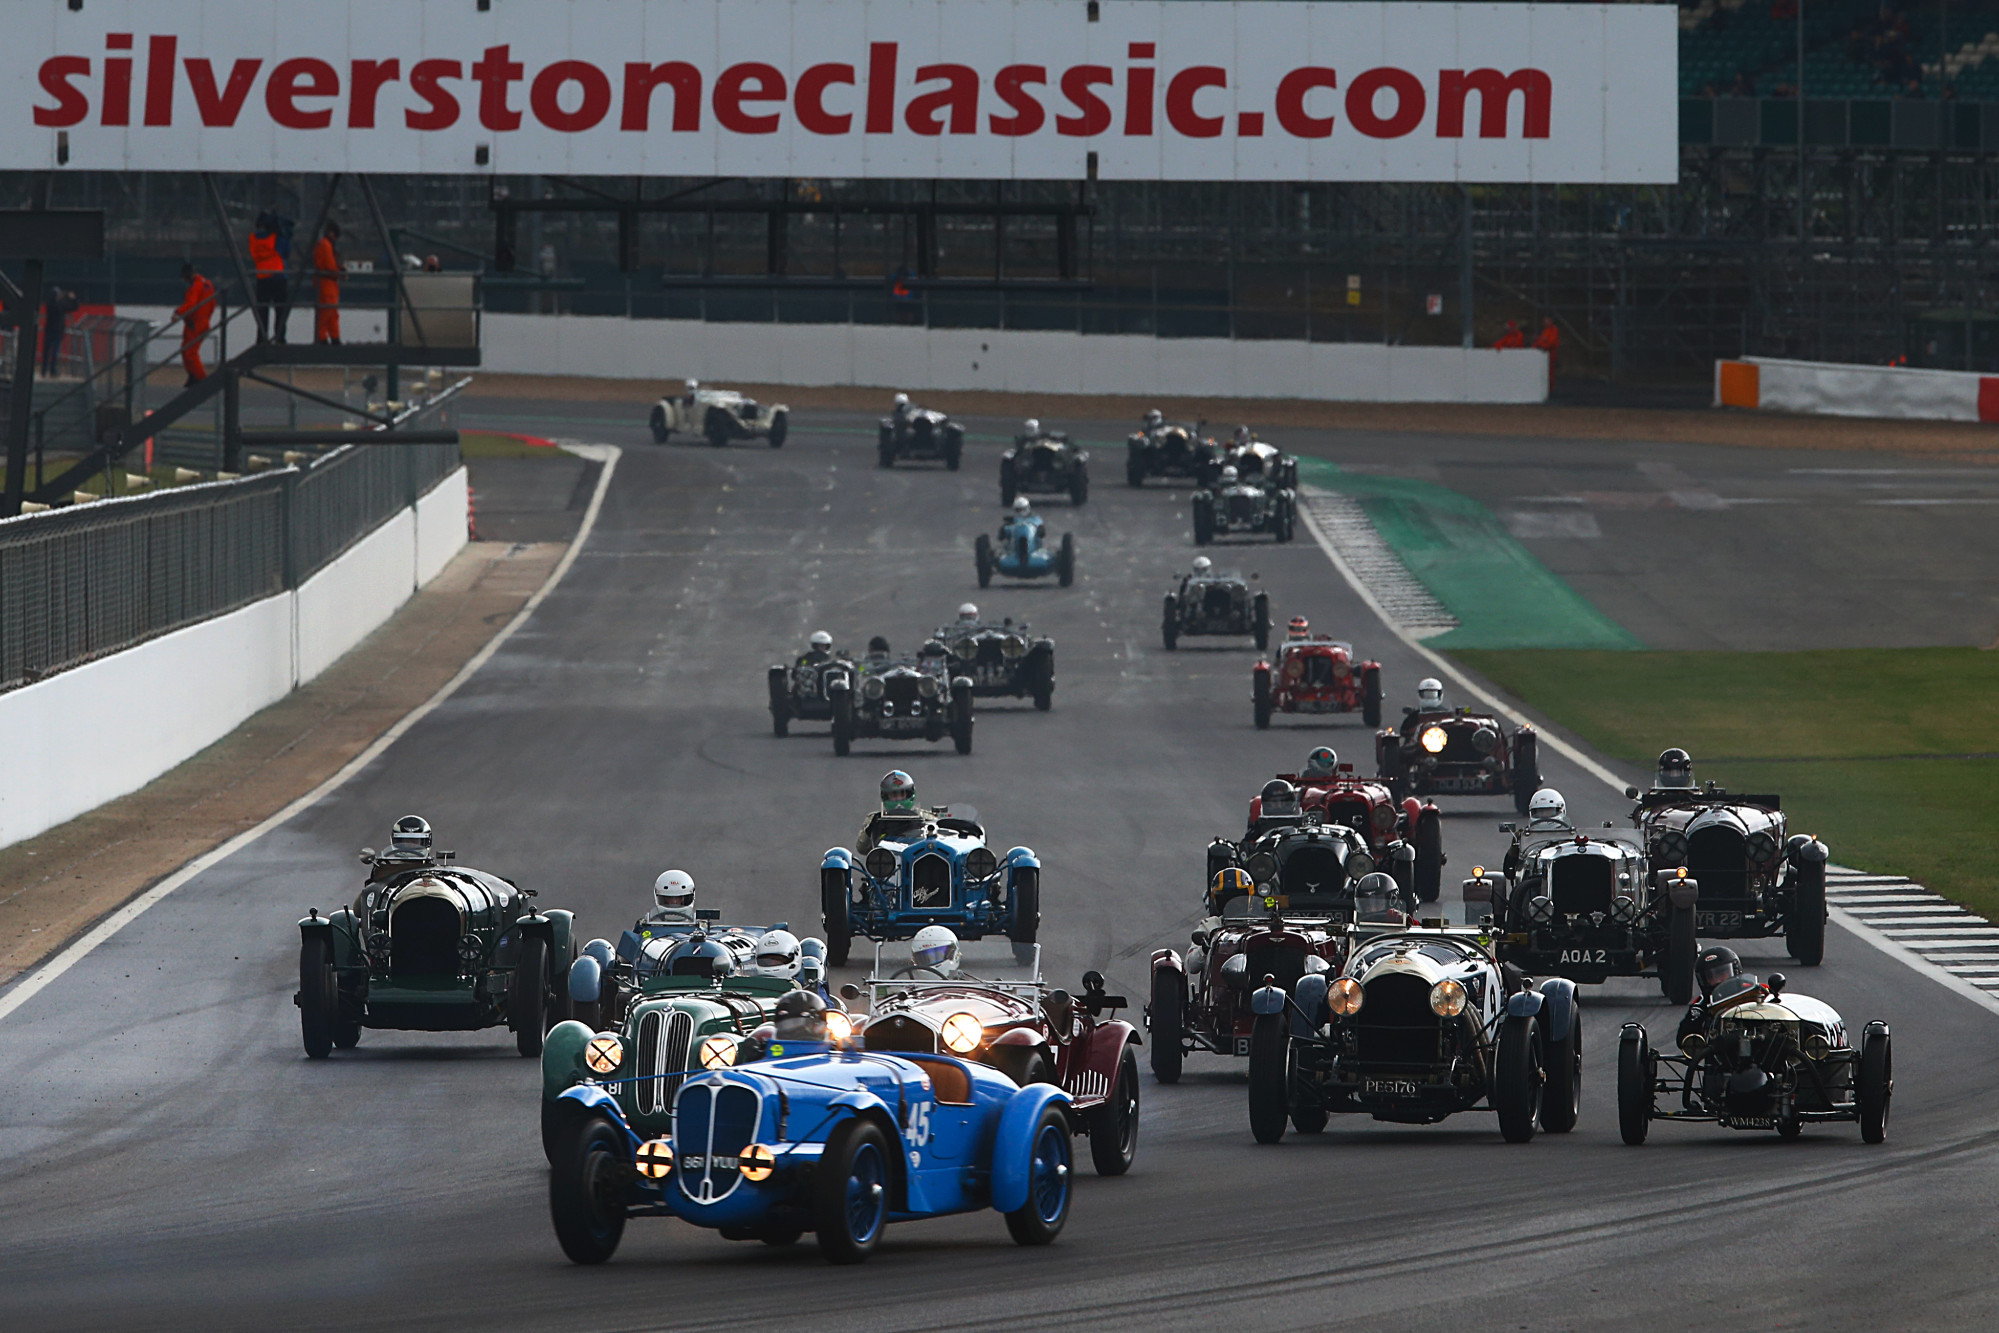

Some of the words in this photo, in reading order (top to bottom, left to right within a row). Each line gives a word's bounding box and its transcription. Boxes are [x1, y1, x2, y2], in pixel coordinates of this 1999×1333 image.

[33, 33, 1552, 138] silverstoneclassic.com
[1720, 912, 1740, 926] 22
[1560, 949, 1592, 963] AOA
[1595, 949, 1606, 963] 2
[905, 1101, 931, 1148] 45
